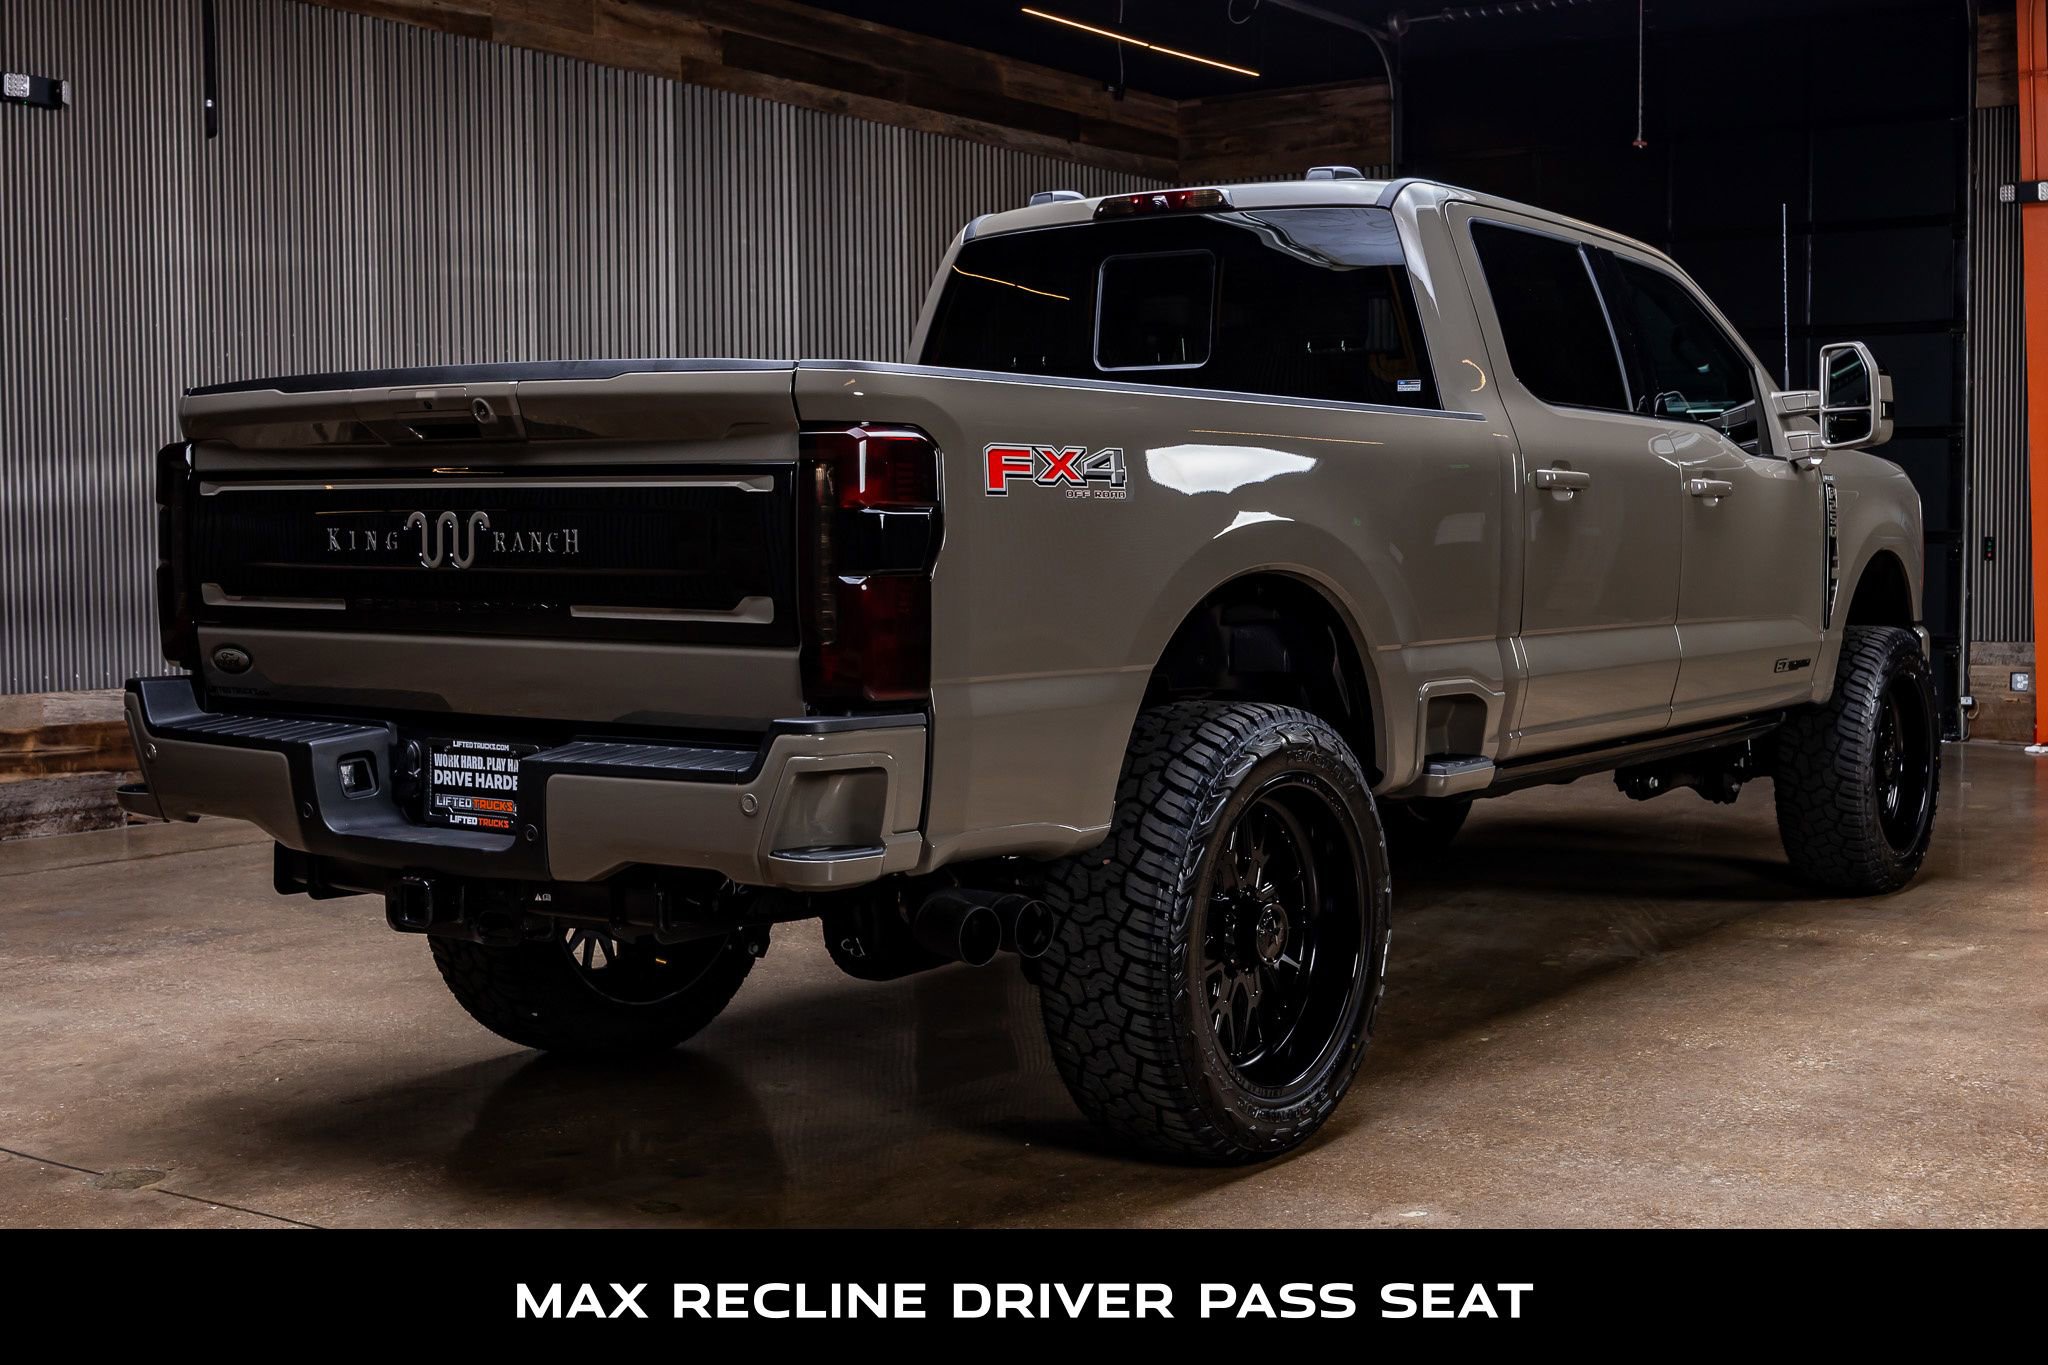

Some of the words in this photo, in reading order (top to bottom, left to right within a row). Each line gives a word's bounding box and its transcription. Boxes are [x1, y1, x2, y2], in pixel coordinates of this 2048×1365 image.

[983, 442, 1127, 497] FX4
[1066, 489, 1090, 499] OFF
[1094, 490, 1126, 499] ROAD
[326, 527, 399, 552] KING
[492, 528, 579, 554] RANCH
[434, 753, 459, 768] WORK
[460, 755, 486, 770] HARD.
[486, 757, 506, 772] PLAY
[434, 769, 473, 787] DRIVE
